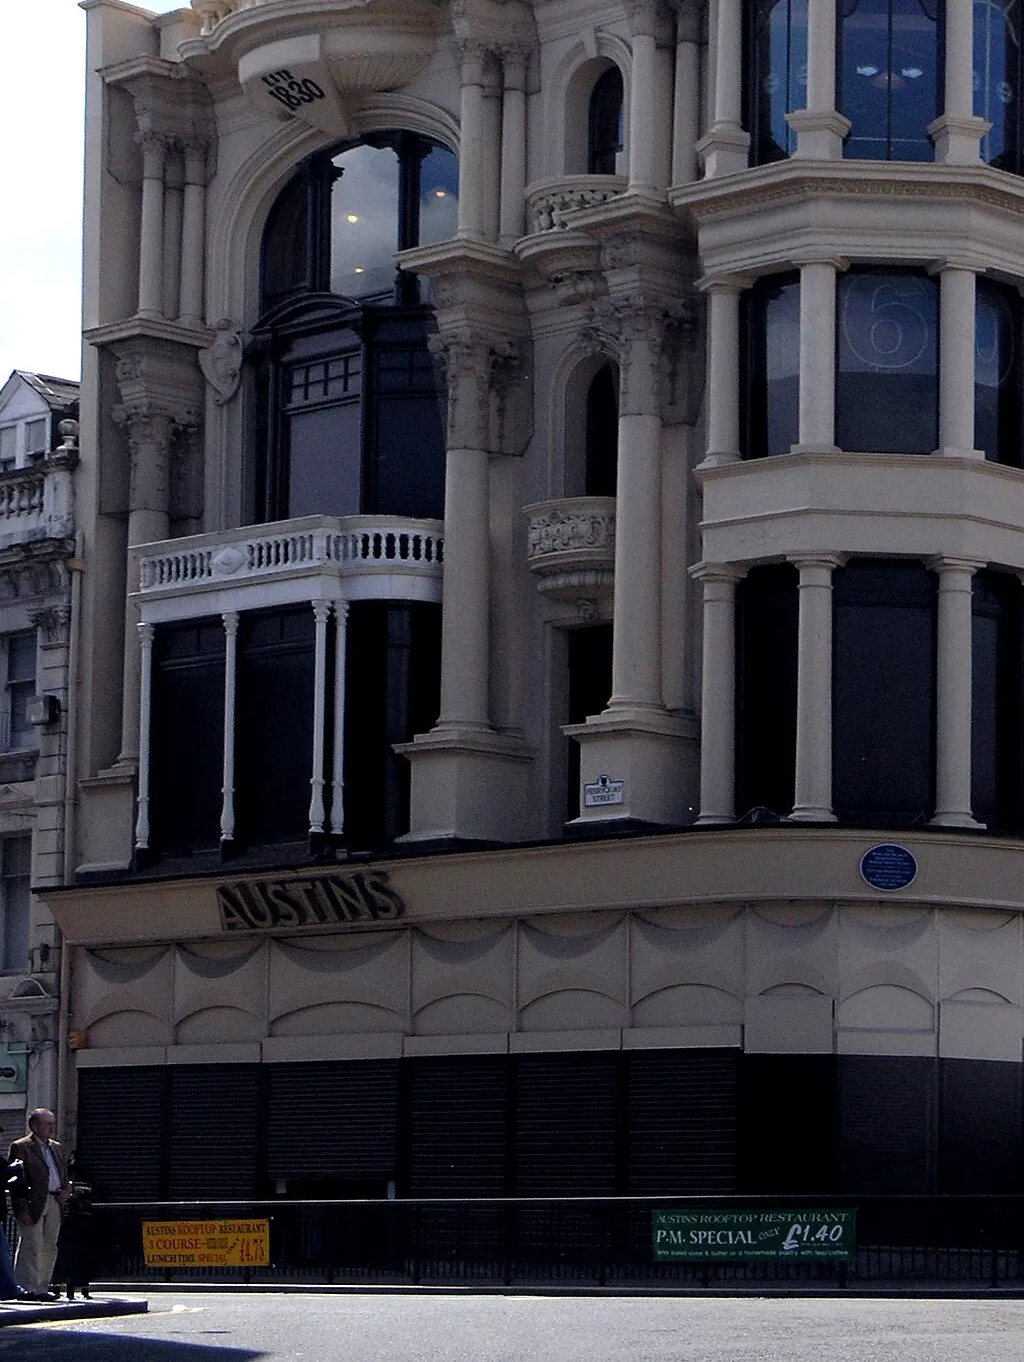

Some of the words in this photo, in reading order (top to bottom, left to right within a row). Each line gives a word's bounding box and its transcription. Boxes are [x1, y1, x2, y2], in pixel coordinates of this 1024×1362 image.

[268, 78, 326, 111] 1830
[216, 871, 405, 931] AUSTINS
[657, 1214, 698, 1224] AUSTINS
[700, 1213, 757, 1224] ROOFTOP
[760, 1213, 848, 1223] RESTAURANT
[146, 1225, 177, 1236] AUSTINS
[178, 1224, 217, 1235] ROOFTOP
[219, 1223, 266, 1234] RESTAURANT
[781, 1223, 844, 1251] £1.40
[689, 1230, 757, 1245] SPECIAL
[146, 1254, 176, 1264] LUNCH
[198, 1253, 227, 1263] SPECIAL
